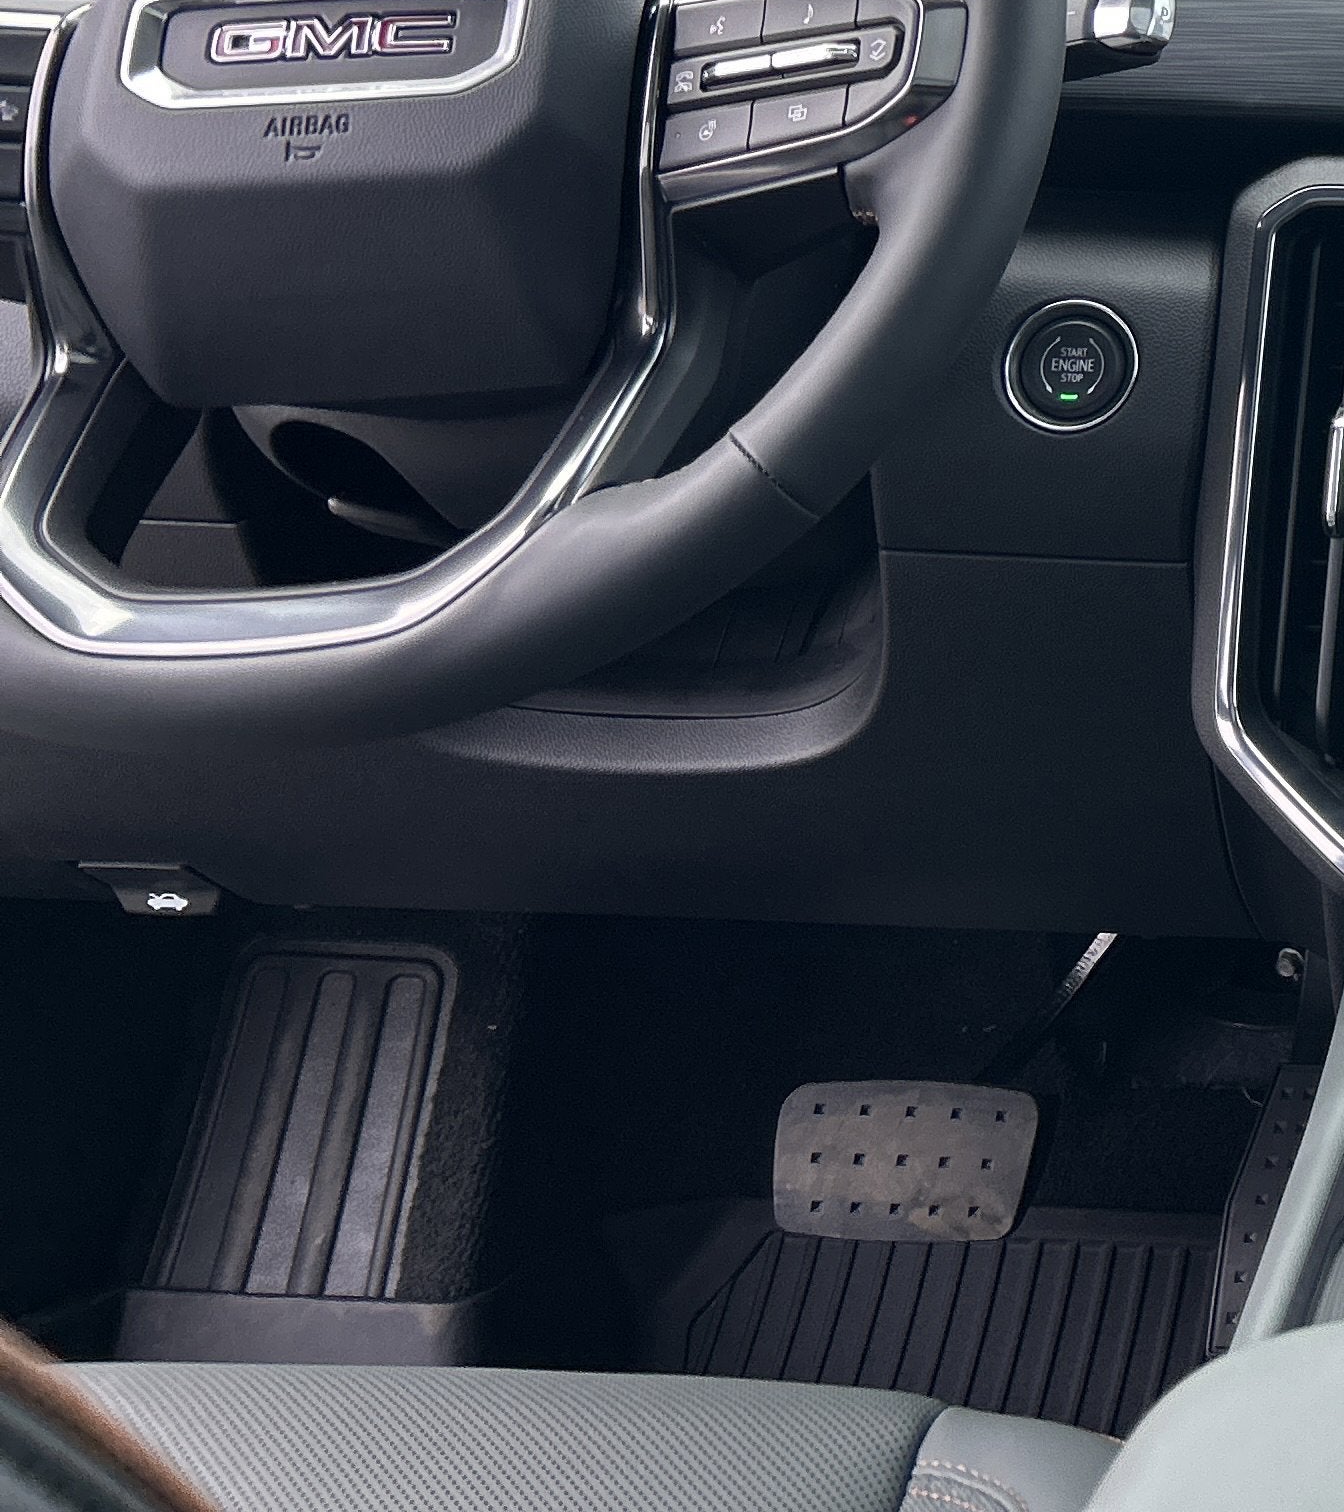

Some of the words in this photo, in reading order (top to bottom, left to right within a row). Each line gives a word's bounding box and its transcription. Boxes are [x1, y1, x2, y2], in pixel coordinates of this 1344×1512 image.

[207, 11, 454, 63] GMC
[263, 113, 349, 138] AIRBAG
[1060, 347, 1088, 357] START
[1051, 358, 1095, 372] ENGINE
[1060, 373, 1083, 383] STOP
